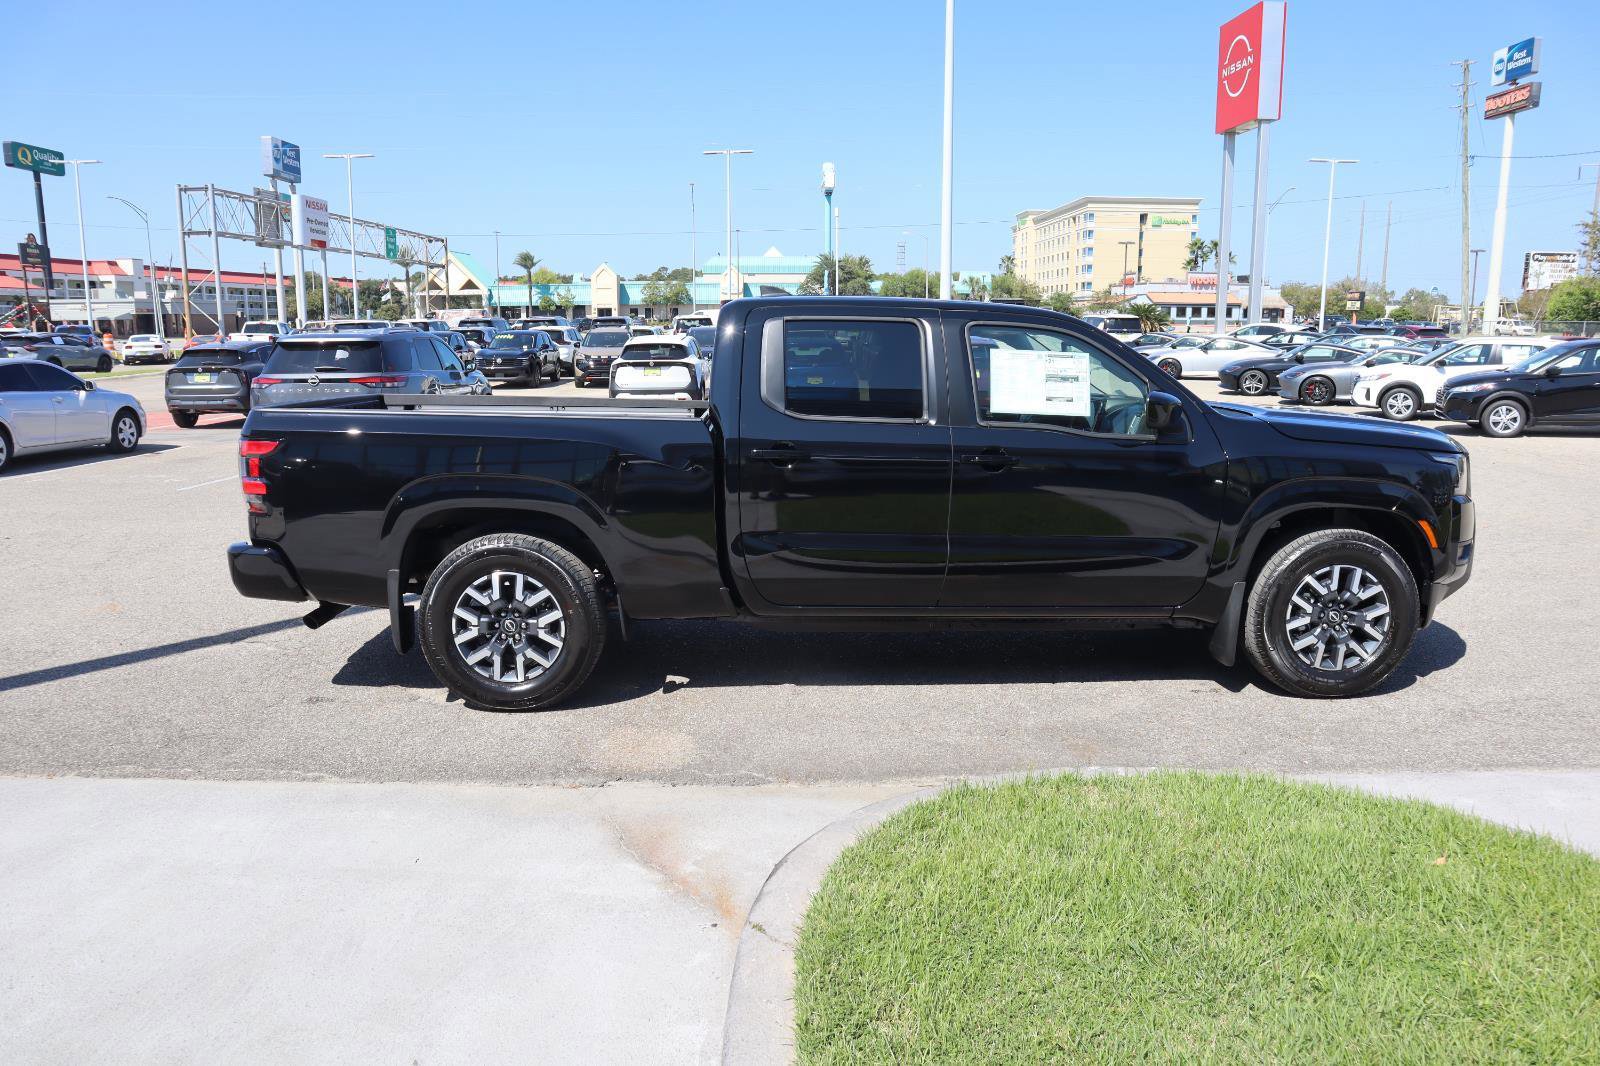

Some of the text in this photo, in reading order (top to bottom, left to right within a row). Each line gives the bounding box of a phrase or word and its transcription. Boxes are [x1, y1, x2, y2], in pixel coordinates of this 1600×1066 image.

[1513, 49, 1527, 61] Best
[1222, 54, 1254, 79] NISSAN
[1507, 56, 1531, 71] Western
[1485, 86, 1530, 110] HOOTERS
[305, 200, 328, 212] NISSAN
[306, 217, 329, 227] Pre-Owned
